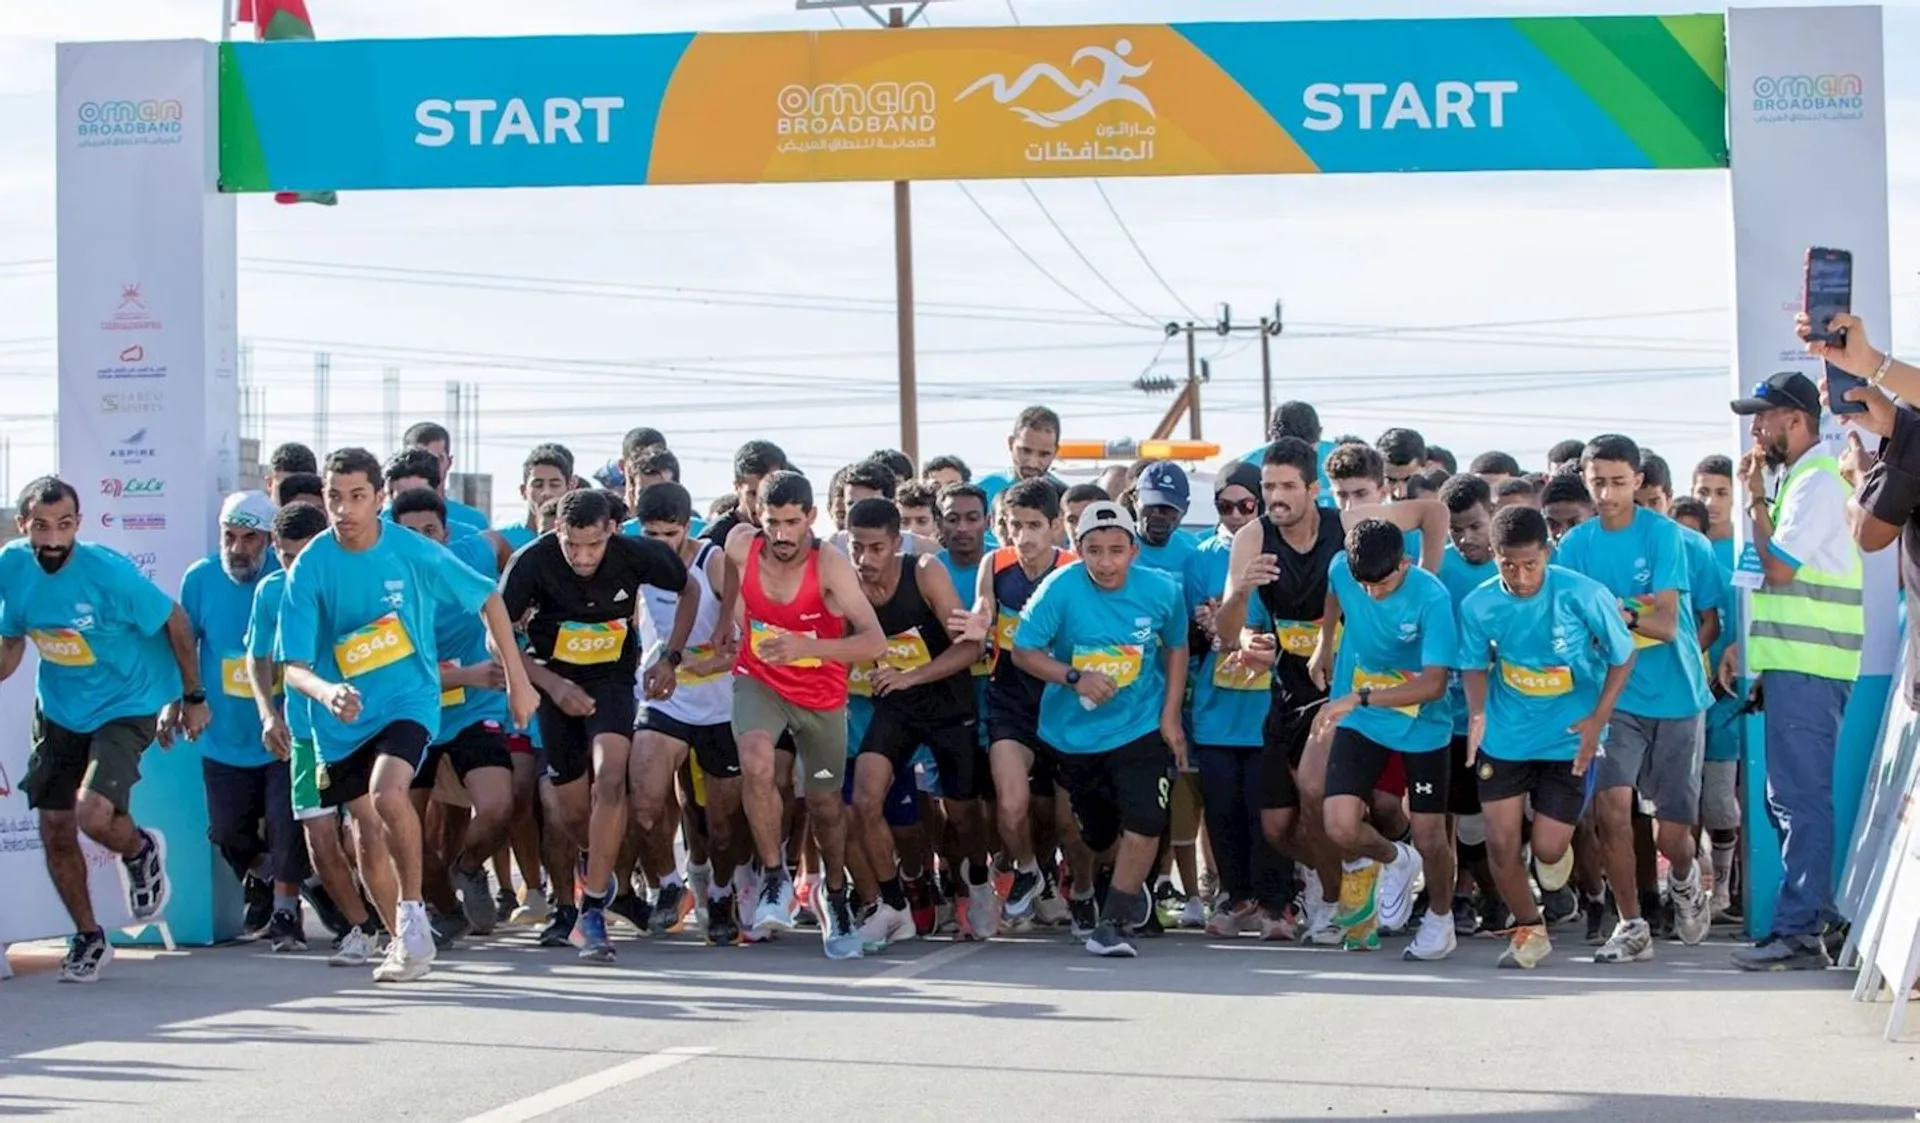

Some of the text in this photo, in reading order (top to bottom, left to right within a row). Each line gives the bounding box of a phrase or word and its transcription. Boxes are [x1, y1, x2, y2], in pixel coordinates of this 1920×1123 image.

[1753, 74, 1862, 98] oman
[778, 82, 935, 117] oman
[1302, 80, 1518, 131] START
[1753, 97, 1862, 111] BROADBAND
[79, 99, 182, 123] oman
[78, 121, 181, 135] BROADBAND
[414, 97, 625, 147] START
[777, 115, 935, 134] BROADBAND
[1096, 121, 1155, 137] ماراثون
[1025, 140, 1153, 161] المحافظات
[109, 448, 156, 457] ASPIRE
[346, 630, 399, 664] 6346
[567, 637, 616, 652] 6393
